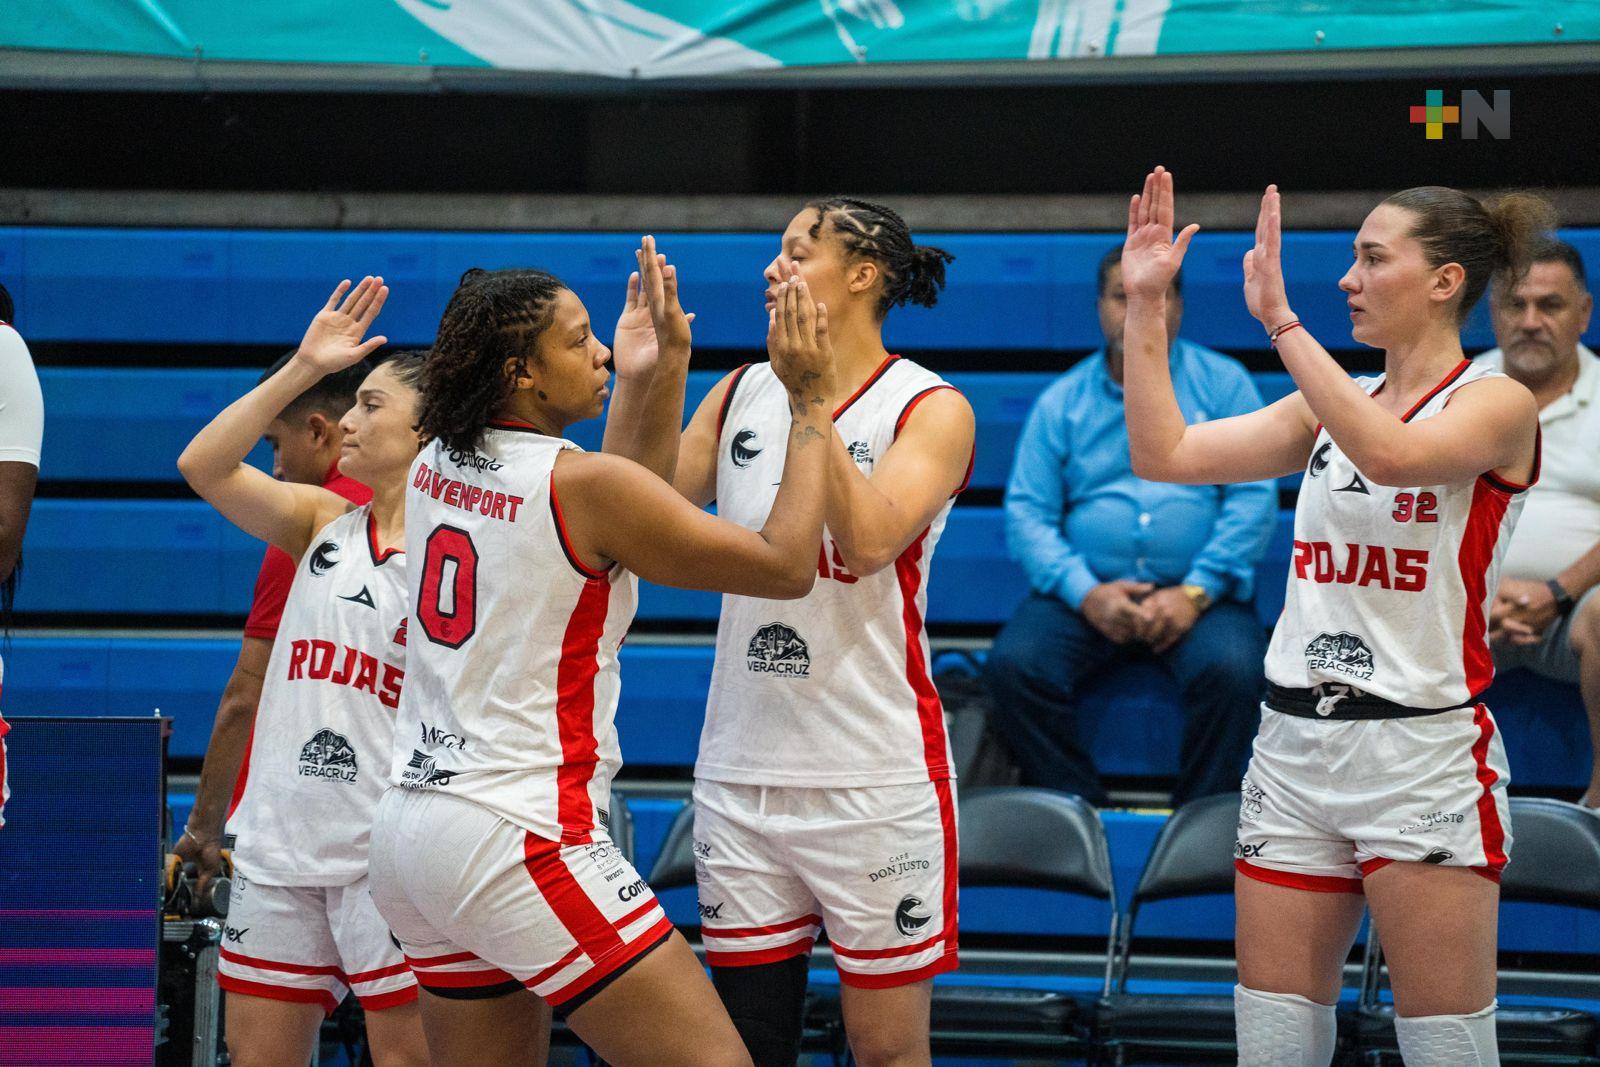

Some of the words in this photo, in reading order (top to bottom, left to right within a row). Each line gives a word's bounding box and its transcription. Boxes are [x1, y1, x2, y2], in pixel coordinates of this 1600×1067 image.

[413, 463, 524, 523] DAVENPORT
[1392, 491, 1438, 523] 32
[416, 523, 479, 650] 0
[1294, 540, 1430, 592] ROJAS
[287, 639, 405, 709] ROJAS
[747, 661, 810, 675] VERACRUZ
[298, 765, 358, 782] VERACRUZ
[868, 865, 897, 882] DON
[898, 860, 930, 875] JUSTO
